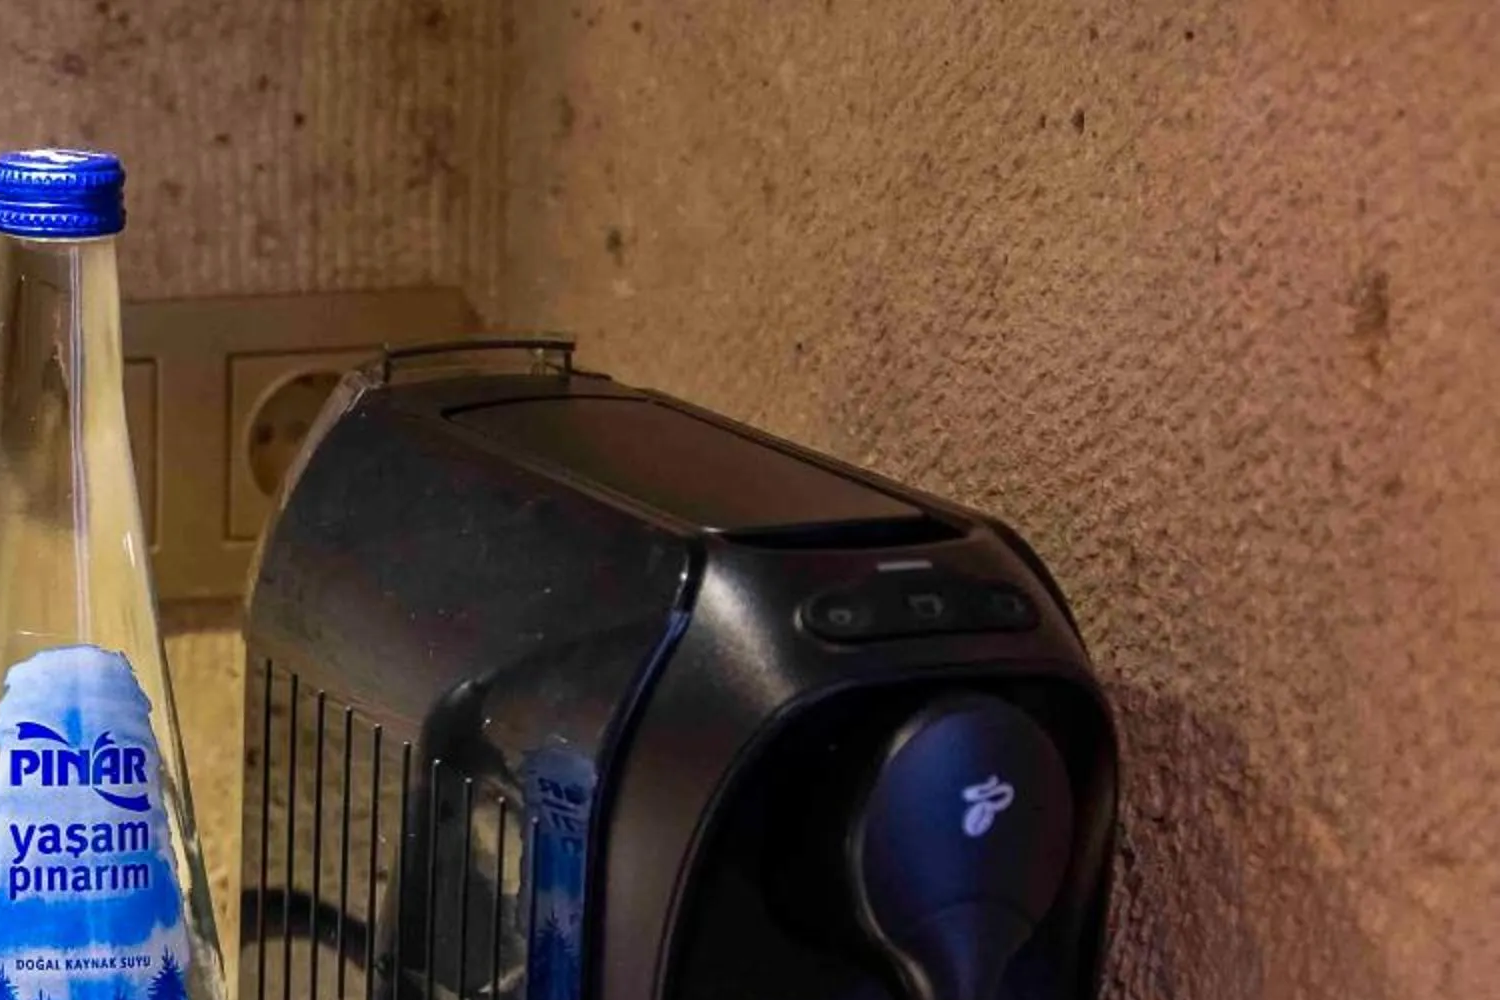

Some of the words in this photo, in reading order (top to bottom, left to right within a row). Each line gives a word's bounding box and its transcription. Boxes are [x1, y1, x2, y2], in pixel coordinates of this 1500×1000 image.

[10, 747, 148, 786] PINAR
[9, 821, 150, 865] yaşam
[9, 863, 149, 900] pınarım
[15, 956, 61, 971] DOĞAL
[65, 957, 117, 970] KAYNAK
[119, 956, 151, 968] SUYU
